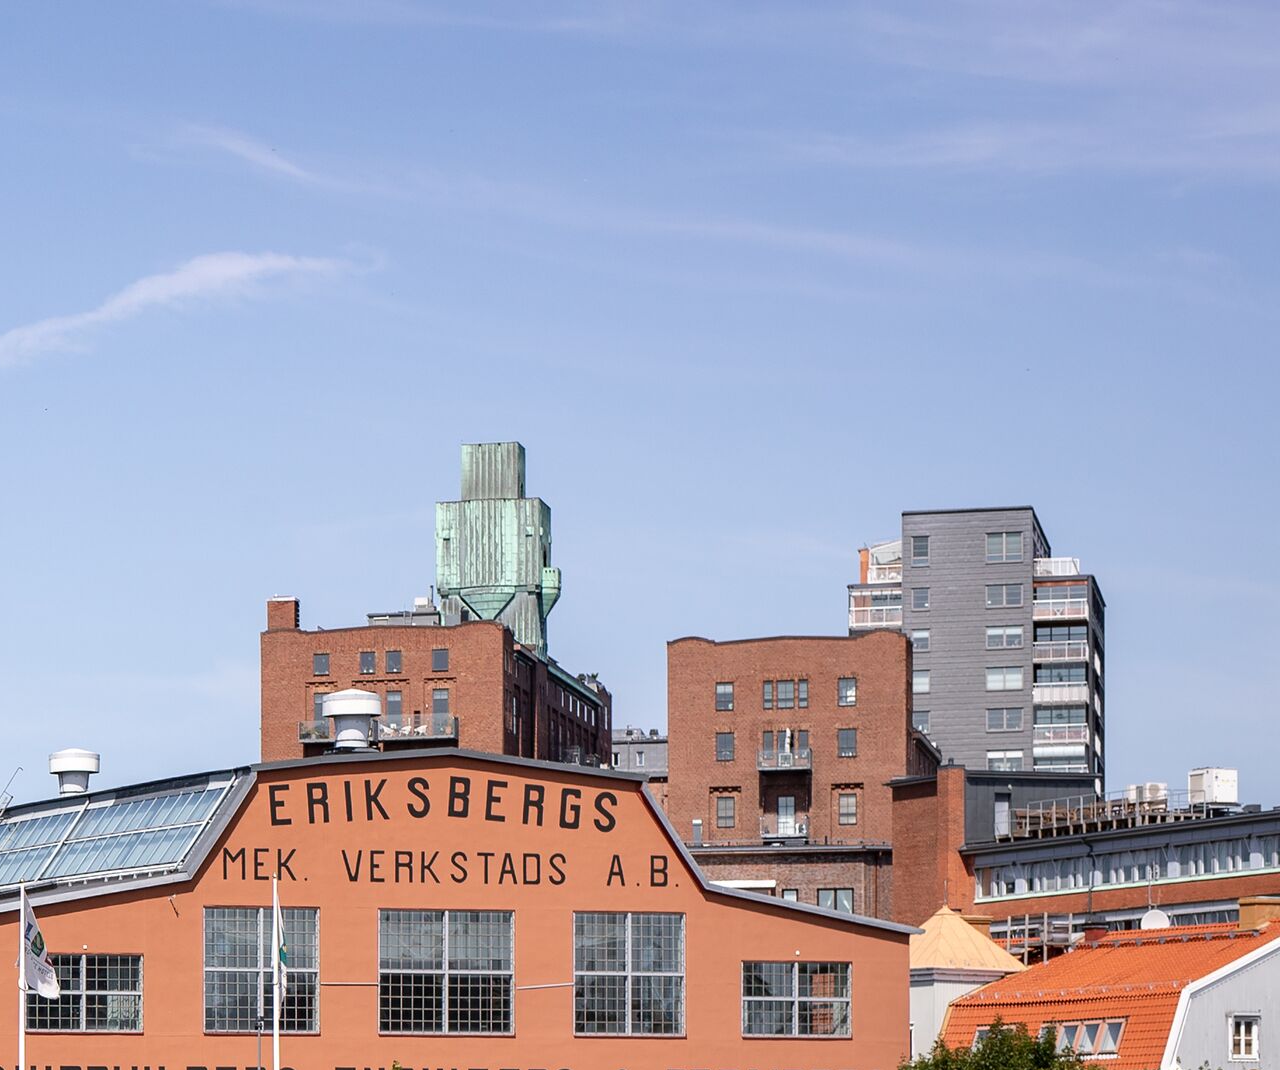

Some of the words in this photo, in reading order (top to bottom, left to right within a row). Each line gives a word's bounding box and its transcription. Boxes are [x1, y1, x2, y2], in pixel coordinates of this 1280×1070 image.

[268, 776, 618, 832] ERIKSBERGS
[222, 847, 309, 881] MEK.
[341, 849, 567, 885] VERKSTADS
[606, 853, 680, 888] A.B.
